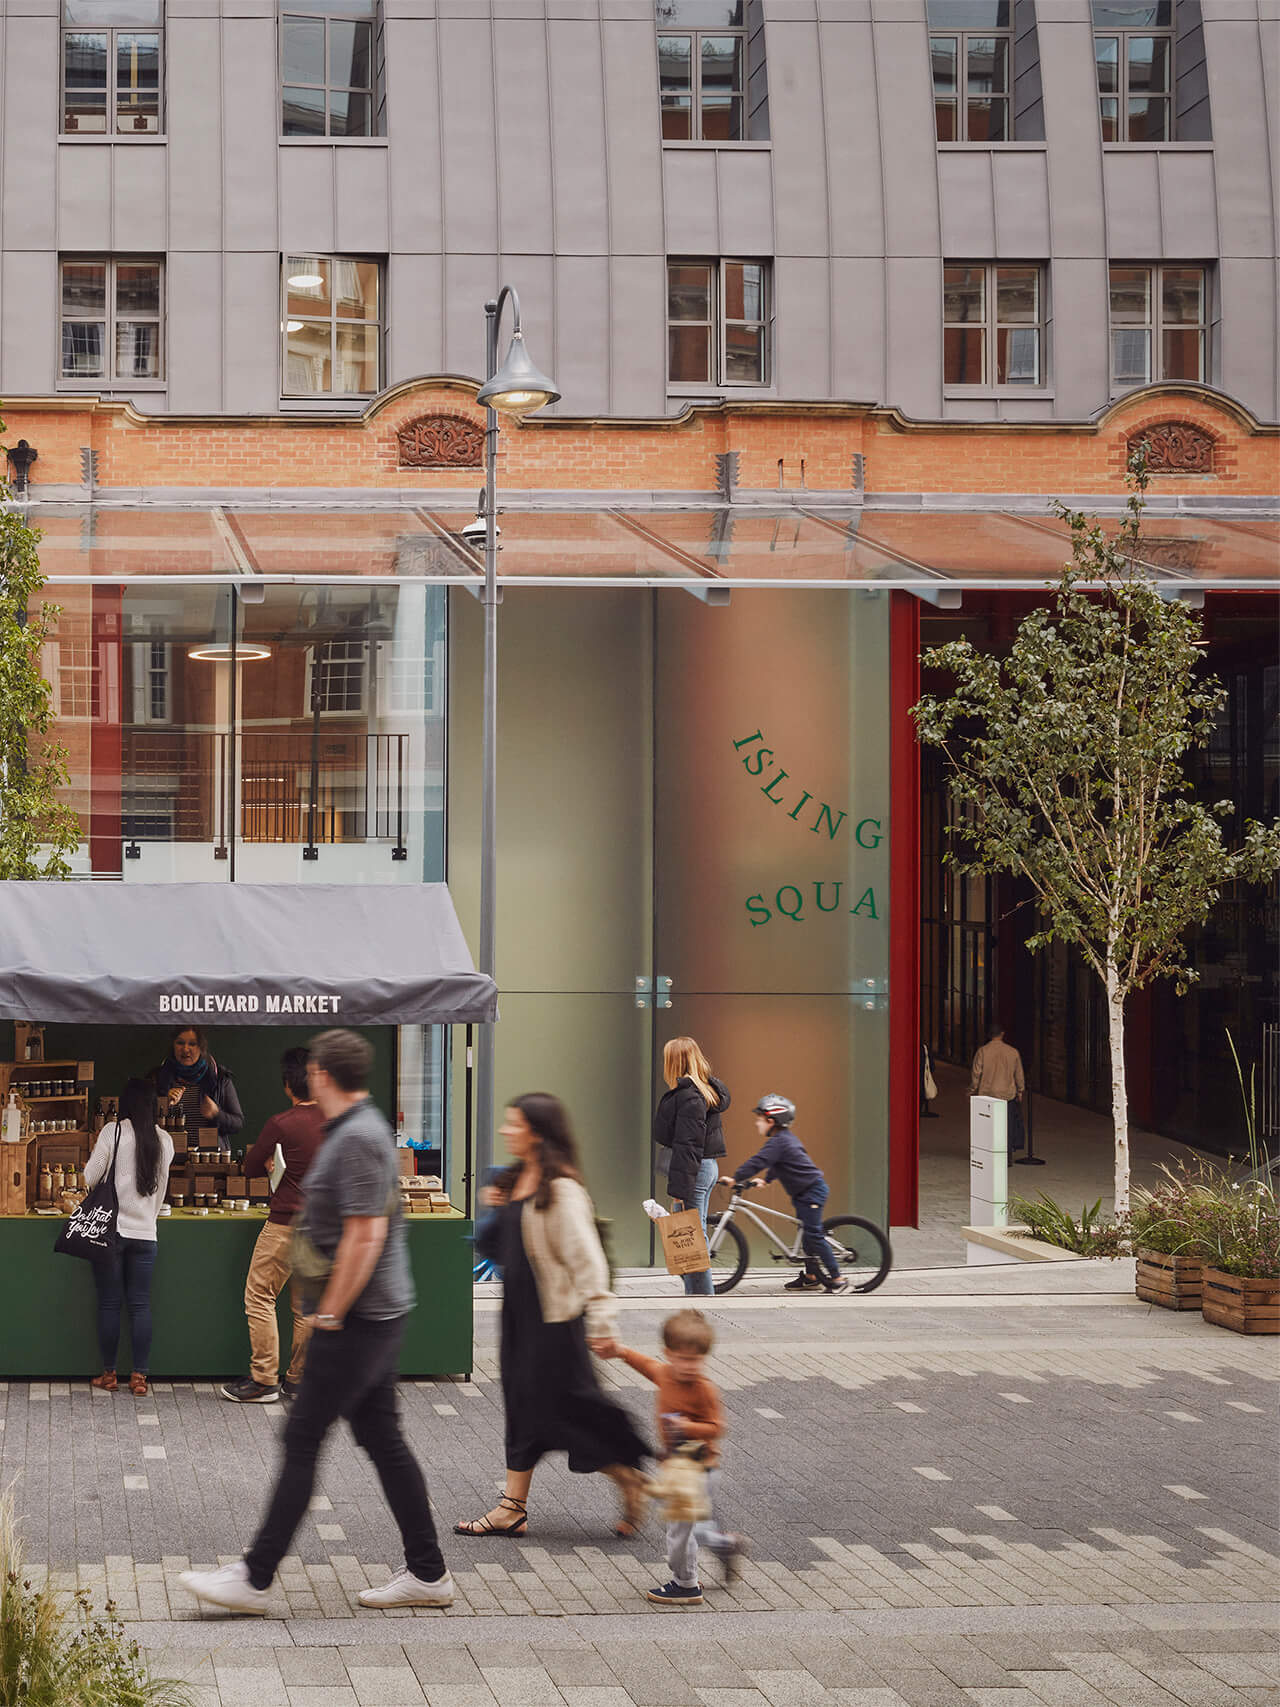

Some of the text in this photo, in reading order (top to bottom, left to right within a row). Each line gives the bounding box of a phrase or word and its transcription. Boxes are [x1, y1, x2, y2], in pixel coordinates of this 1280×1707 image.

[732, 729, 883, 849] ISLING
[745, 881, 880, 927] SQUA
[159, 995, 341, 1013] BOULEVARD MARKET
